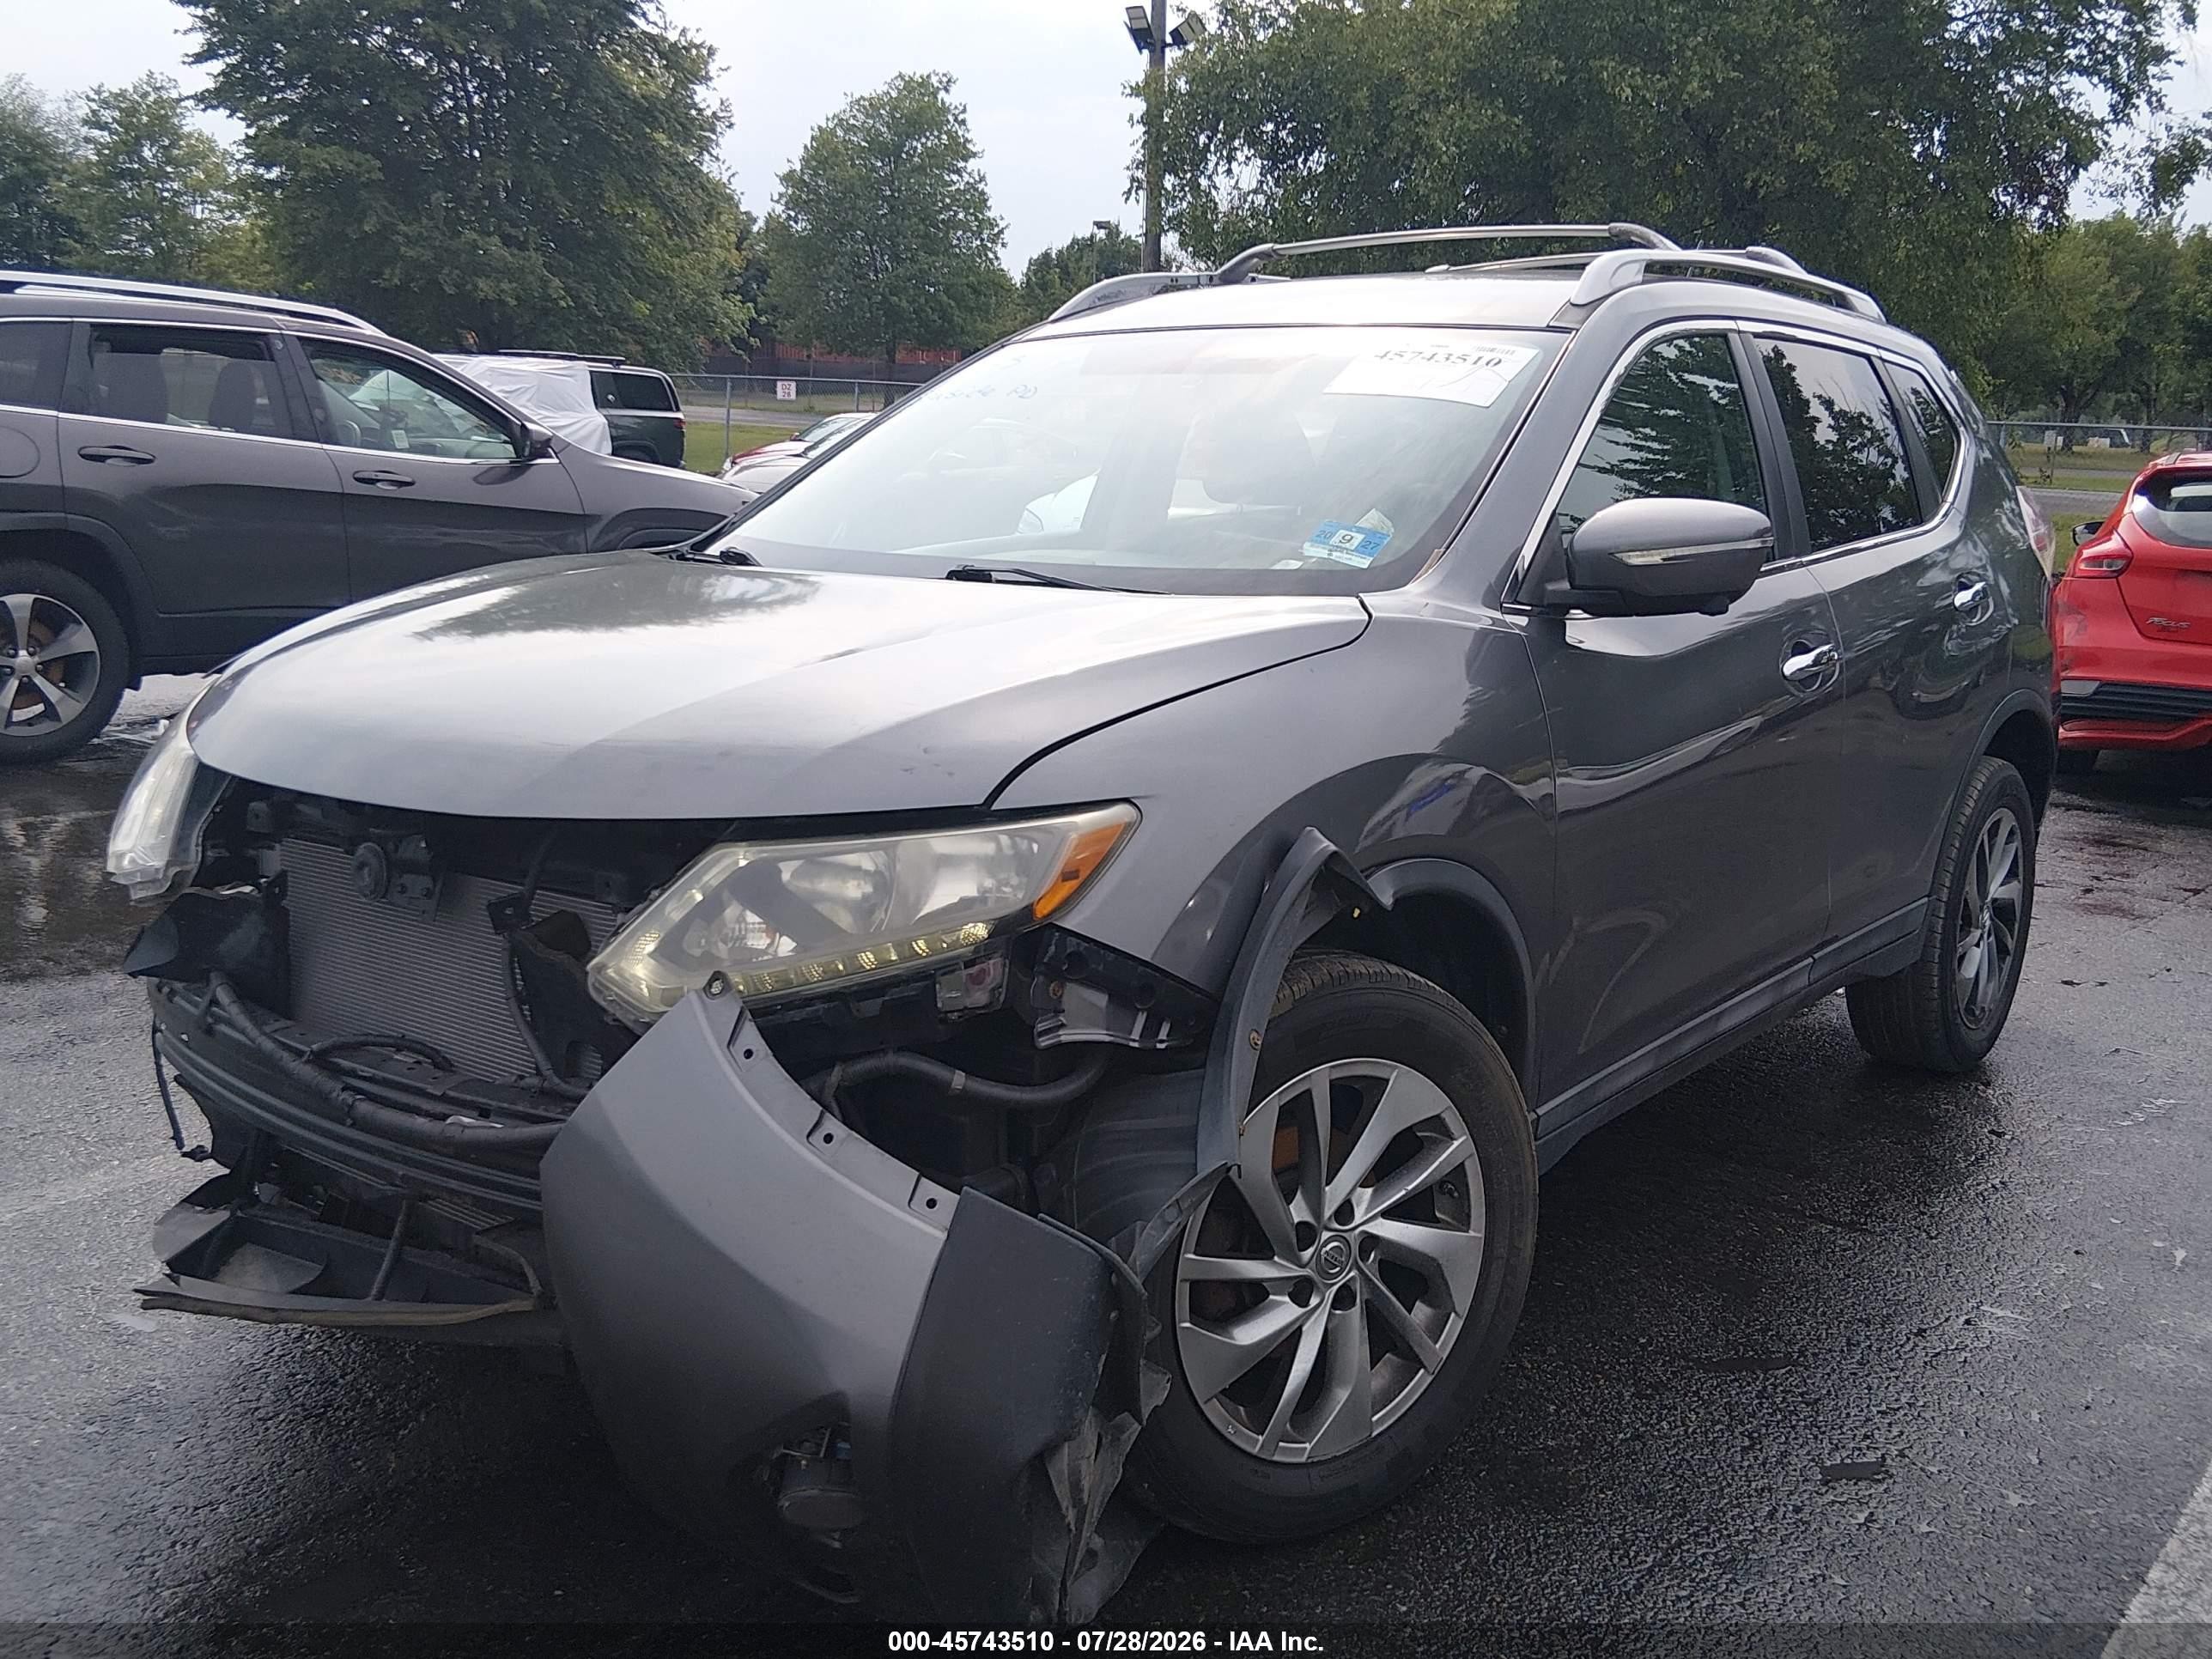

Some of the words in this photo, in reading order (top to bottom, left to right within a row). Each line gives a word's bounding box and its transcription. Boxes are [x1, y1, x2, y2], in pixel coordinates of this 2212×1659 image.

[1315, 530, 1334, 540] 20
[1339, 533, 1354, 544] 9
[1359, 540, 1380, 550] 27
